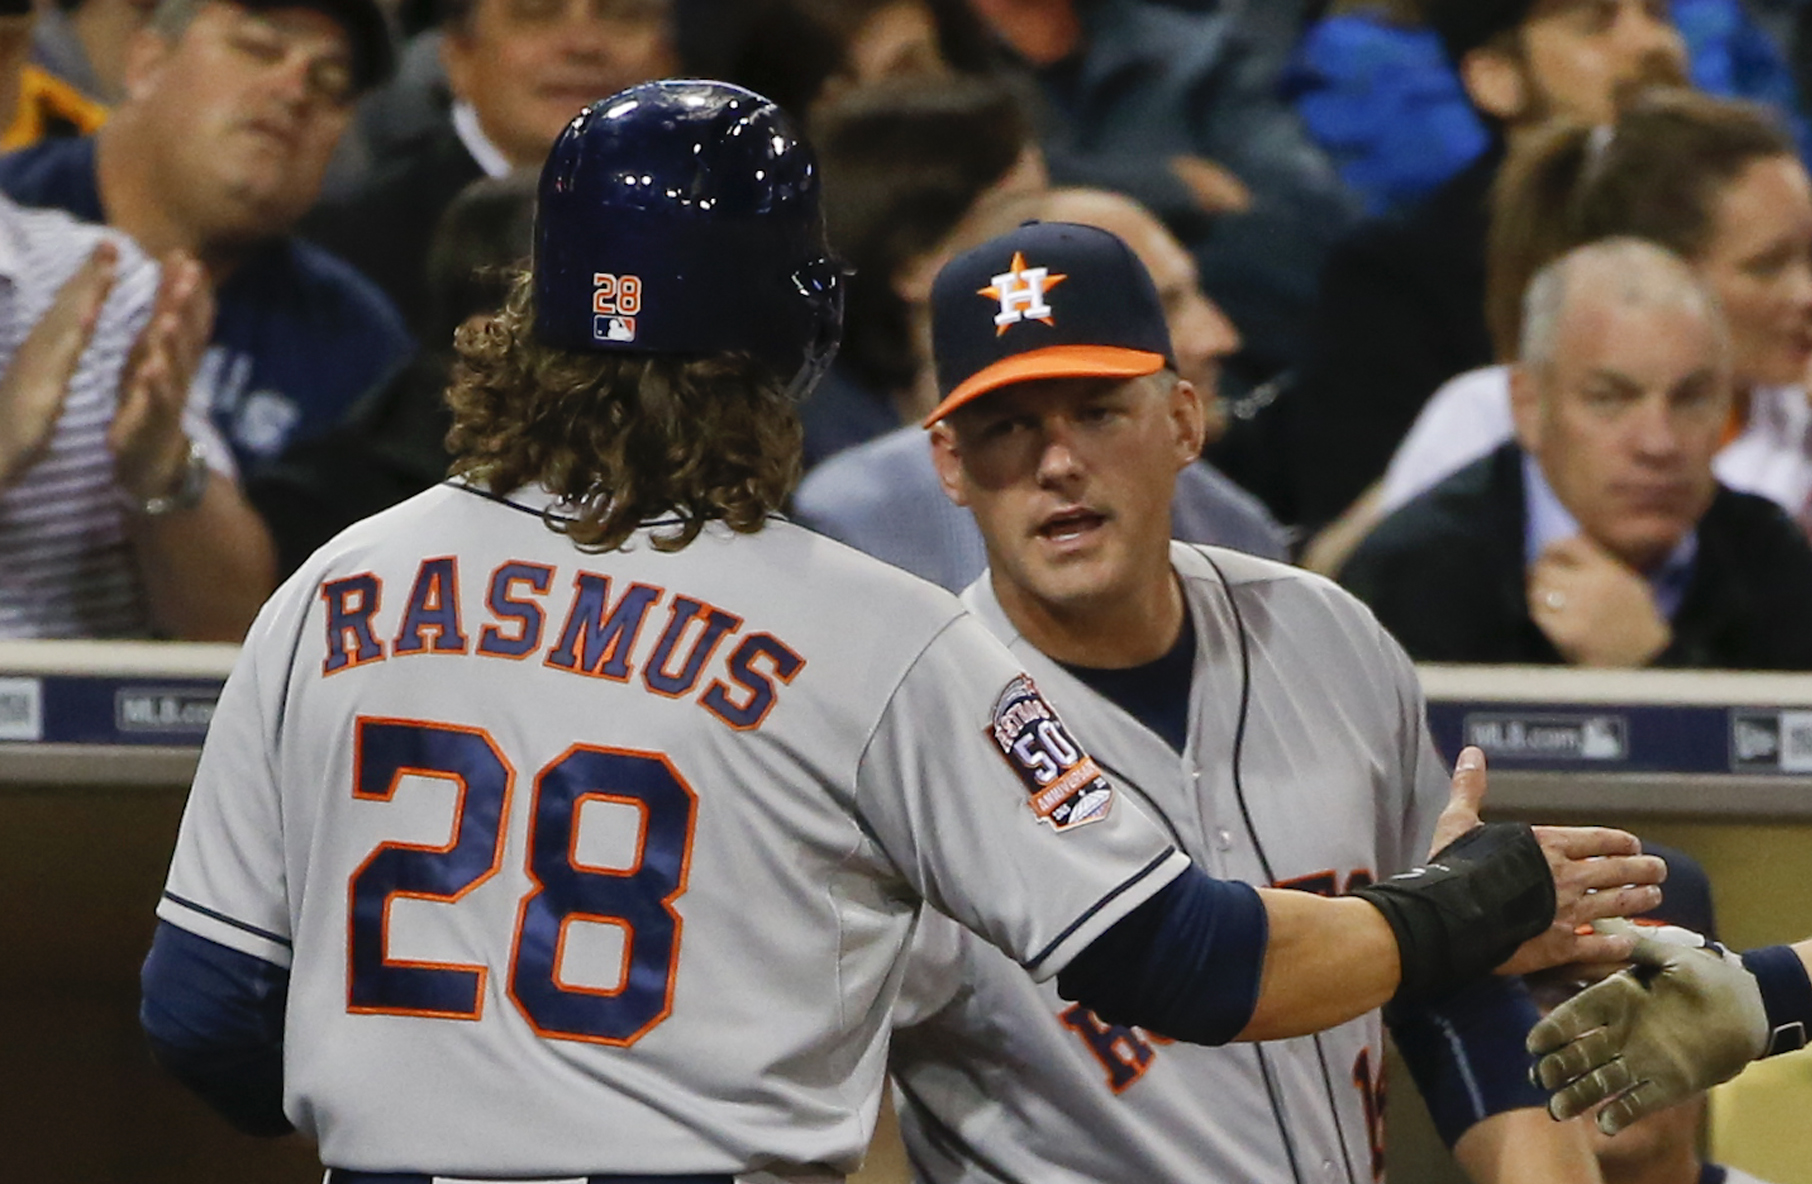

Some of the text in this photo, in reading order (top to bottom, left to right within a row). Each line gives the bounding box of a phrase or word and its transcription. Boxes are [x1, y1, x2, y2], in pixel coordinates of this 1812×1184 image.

[593, 272, 642, 316] 28
[991, 266, 1052, 326] H
[320, 555, 807, 732] RASMUS
[1014, 720, 1078, 786] 50
[346, 715, 699, 1048] 28
